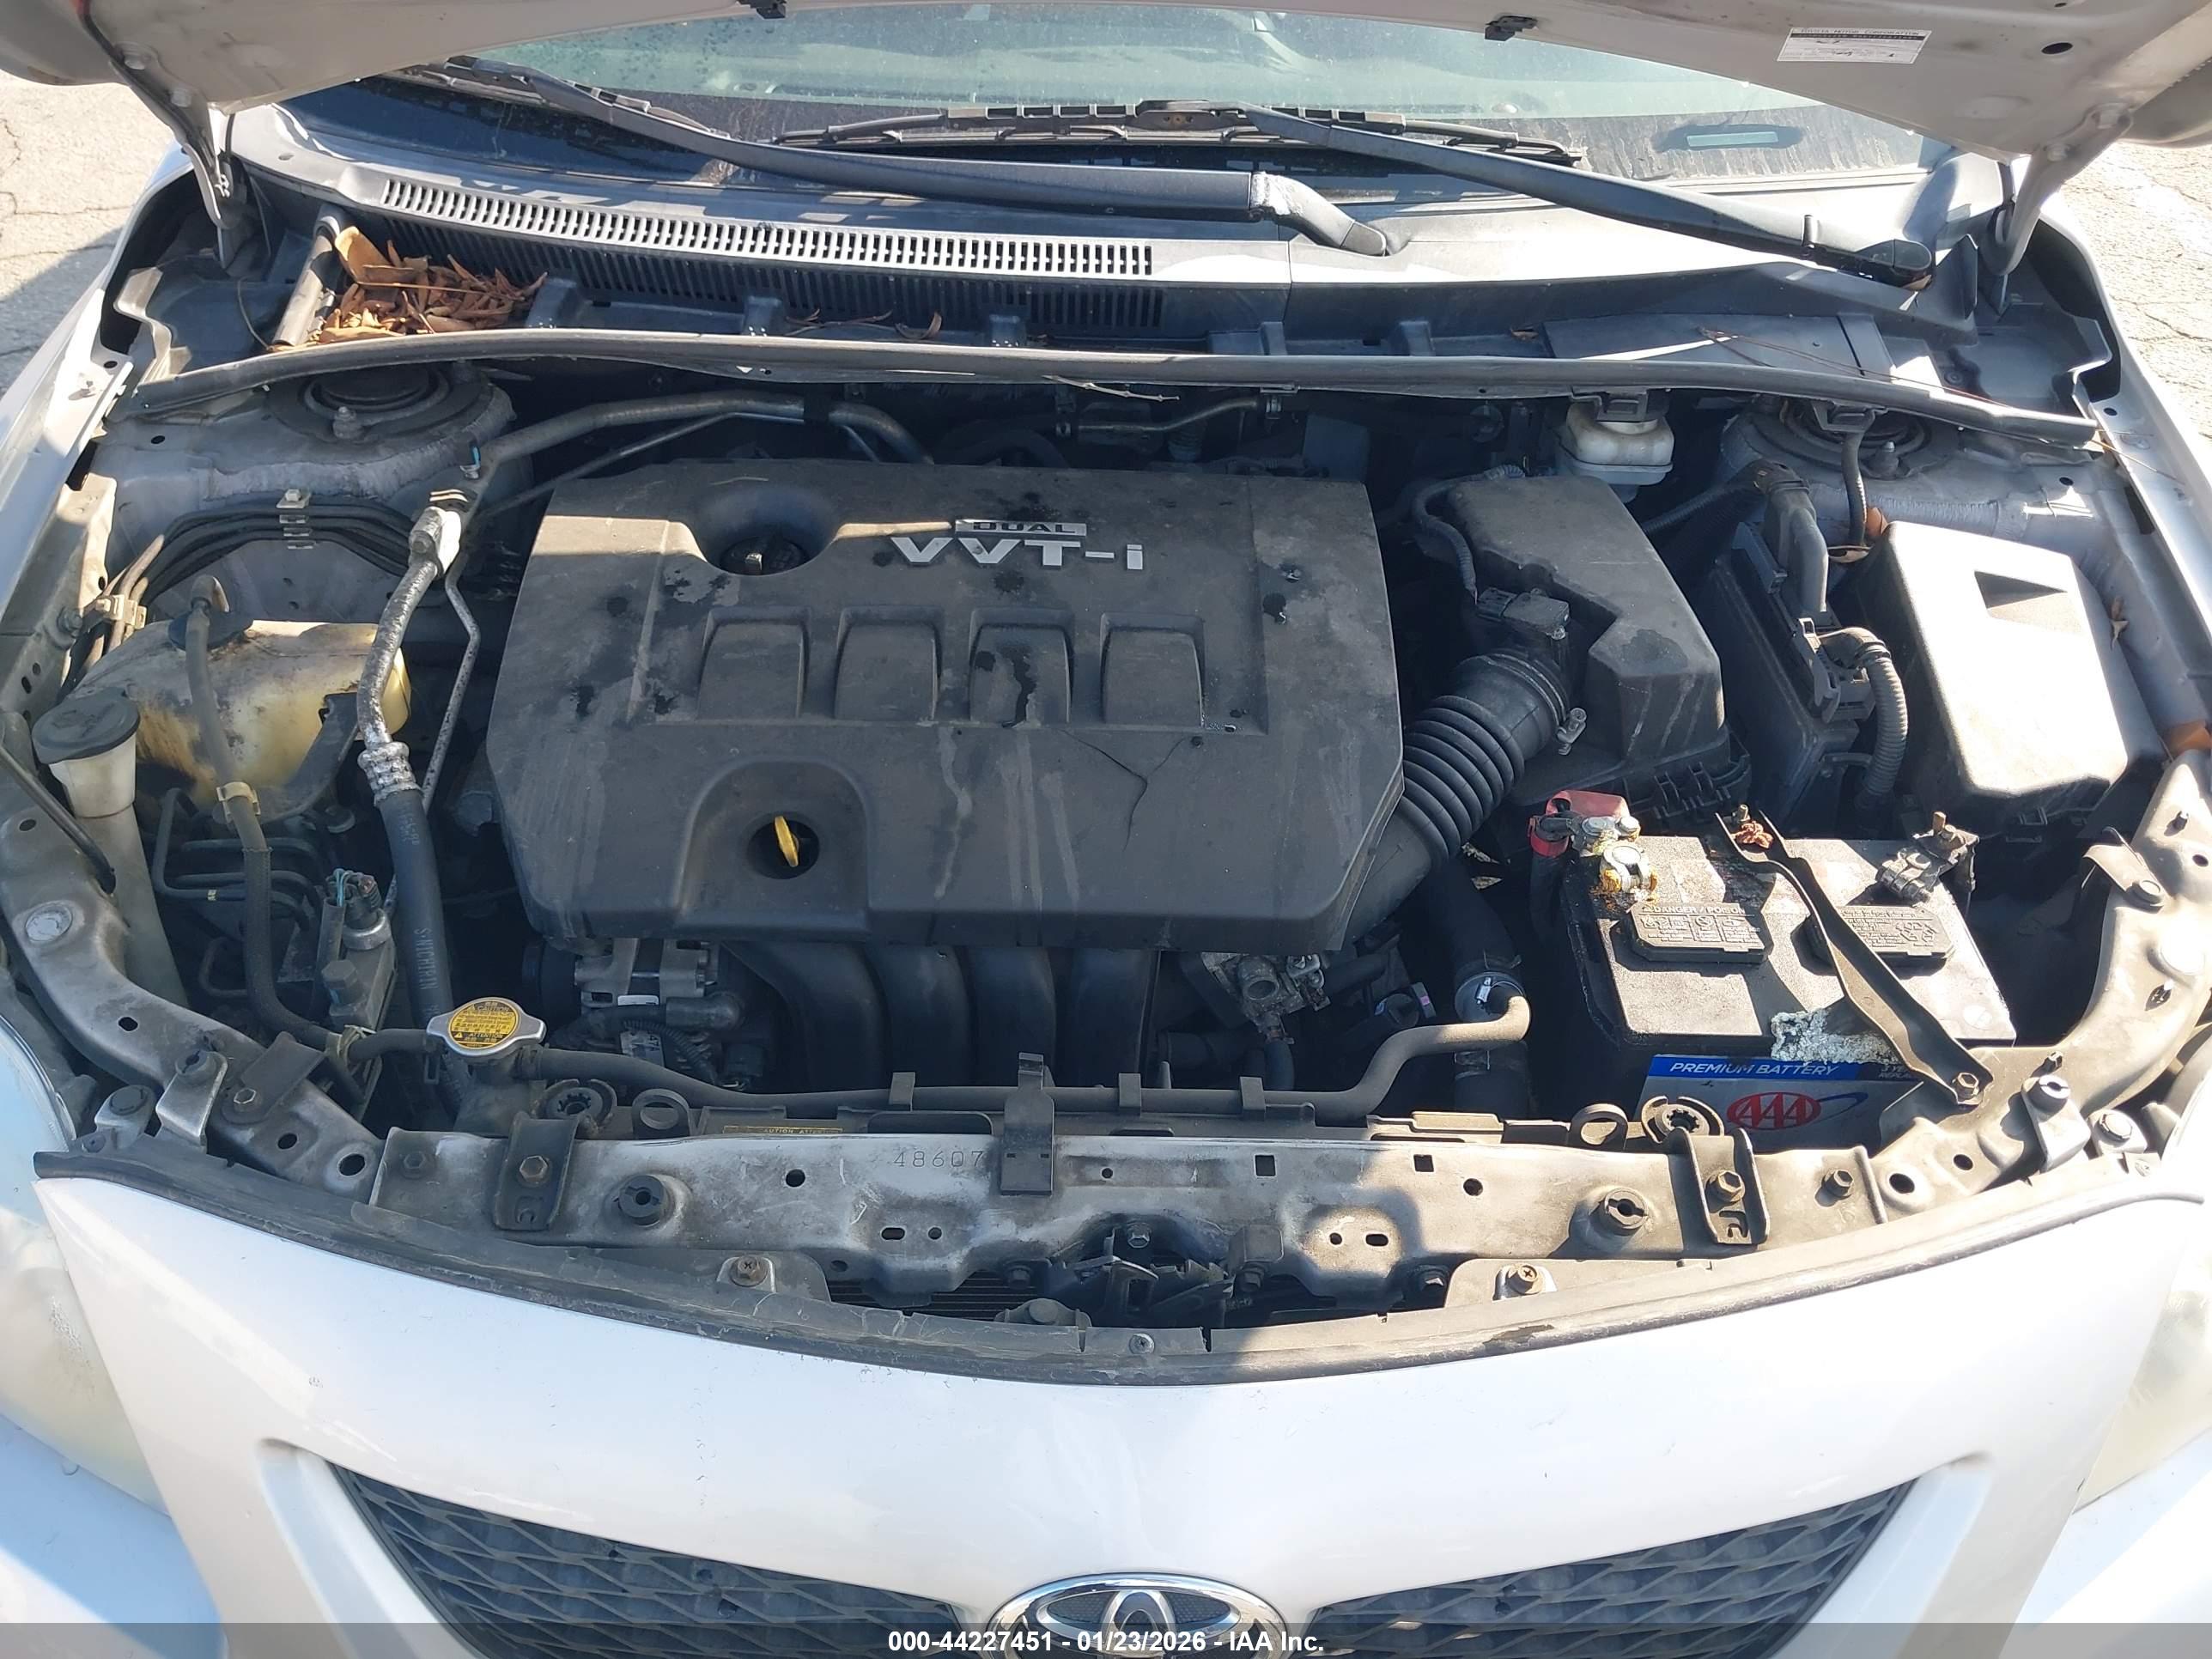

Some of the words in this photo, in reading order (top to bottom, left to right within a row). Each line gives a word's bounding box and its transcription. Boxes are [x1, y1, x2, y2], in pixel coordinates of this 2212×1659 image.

[973, 521, 1075, 534] DUAL
[890, 537, 1143, 570] VVT-i
[1669, 1061, 1756, 1074] PREMIUM
[1758, 1063, 1838, 1076] BATTERY
[1735, 1094, 1814, 1128] AAA
[893, 1151, 983, 1168] 48607
